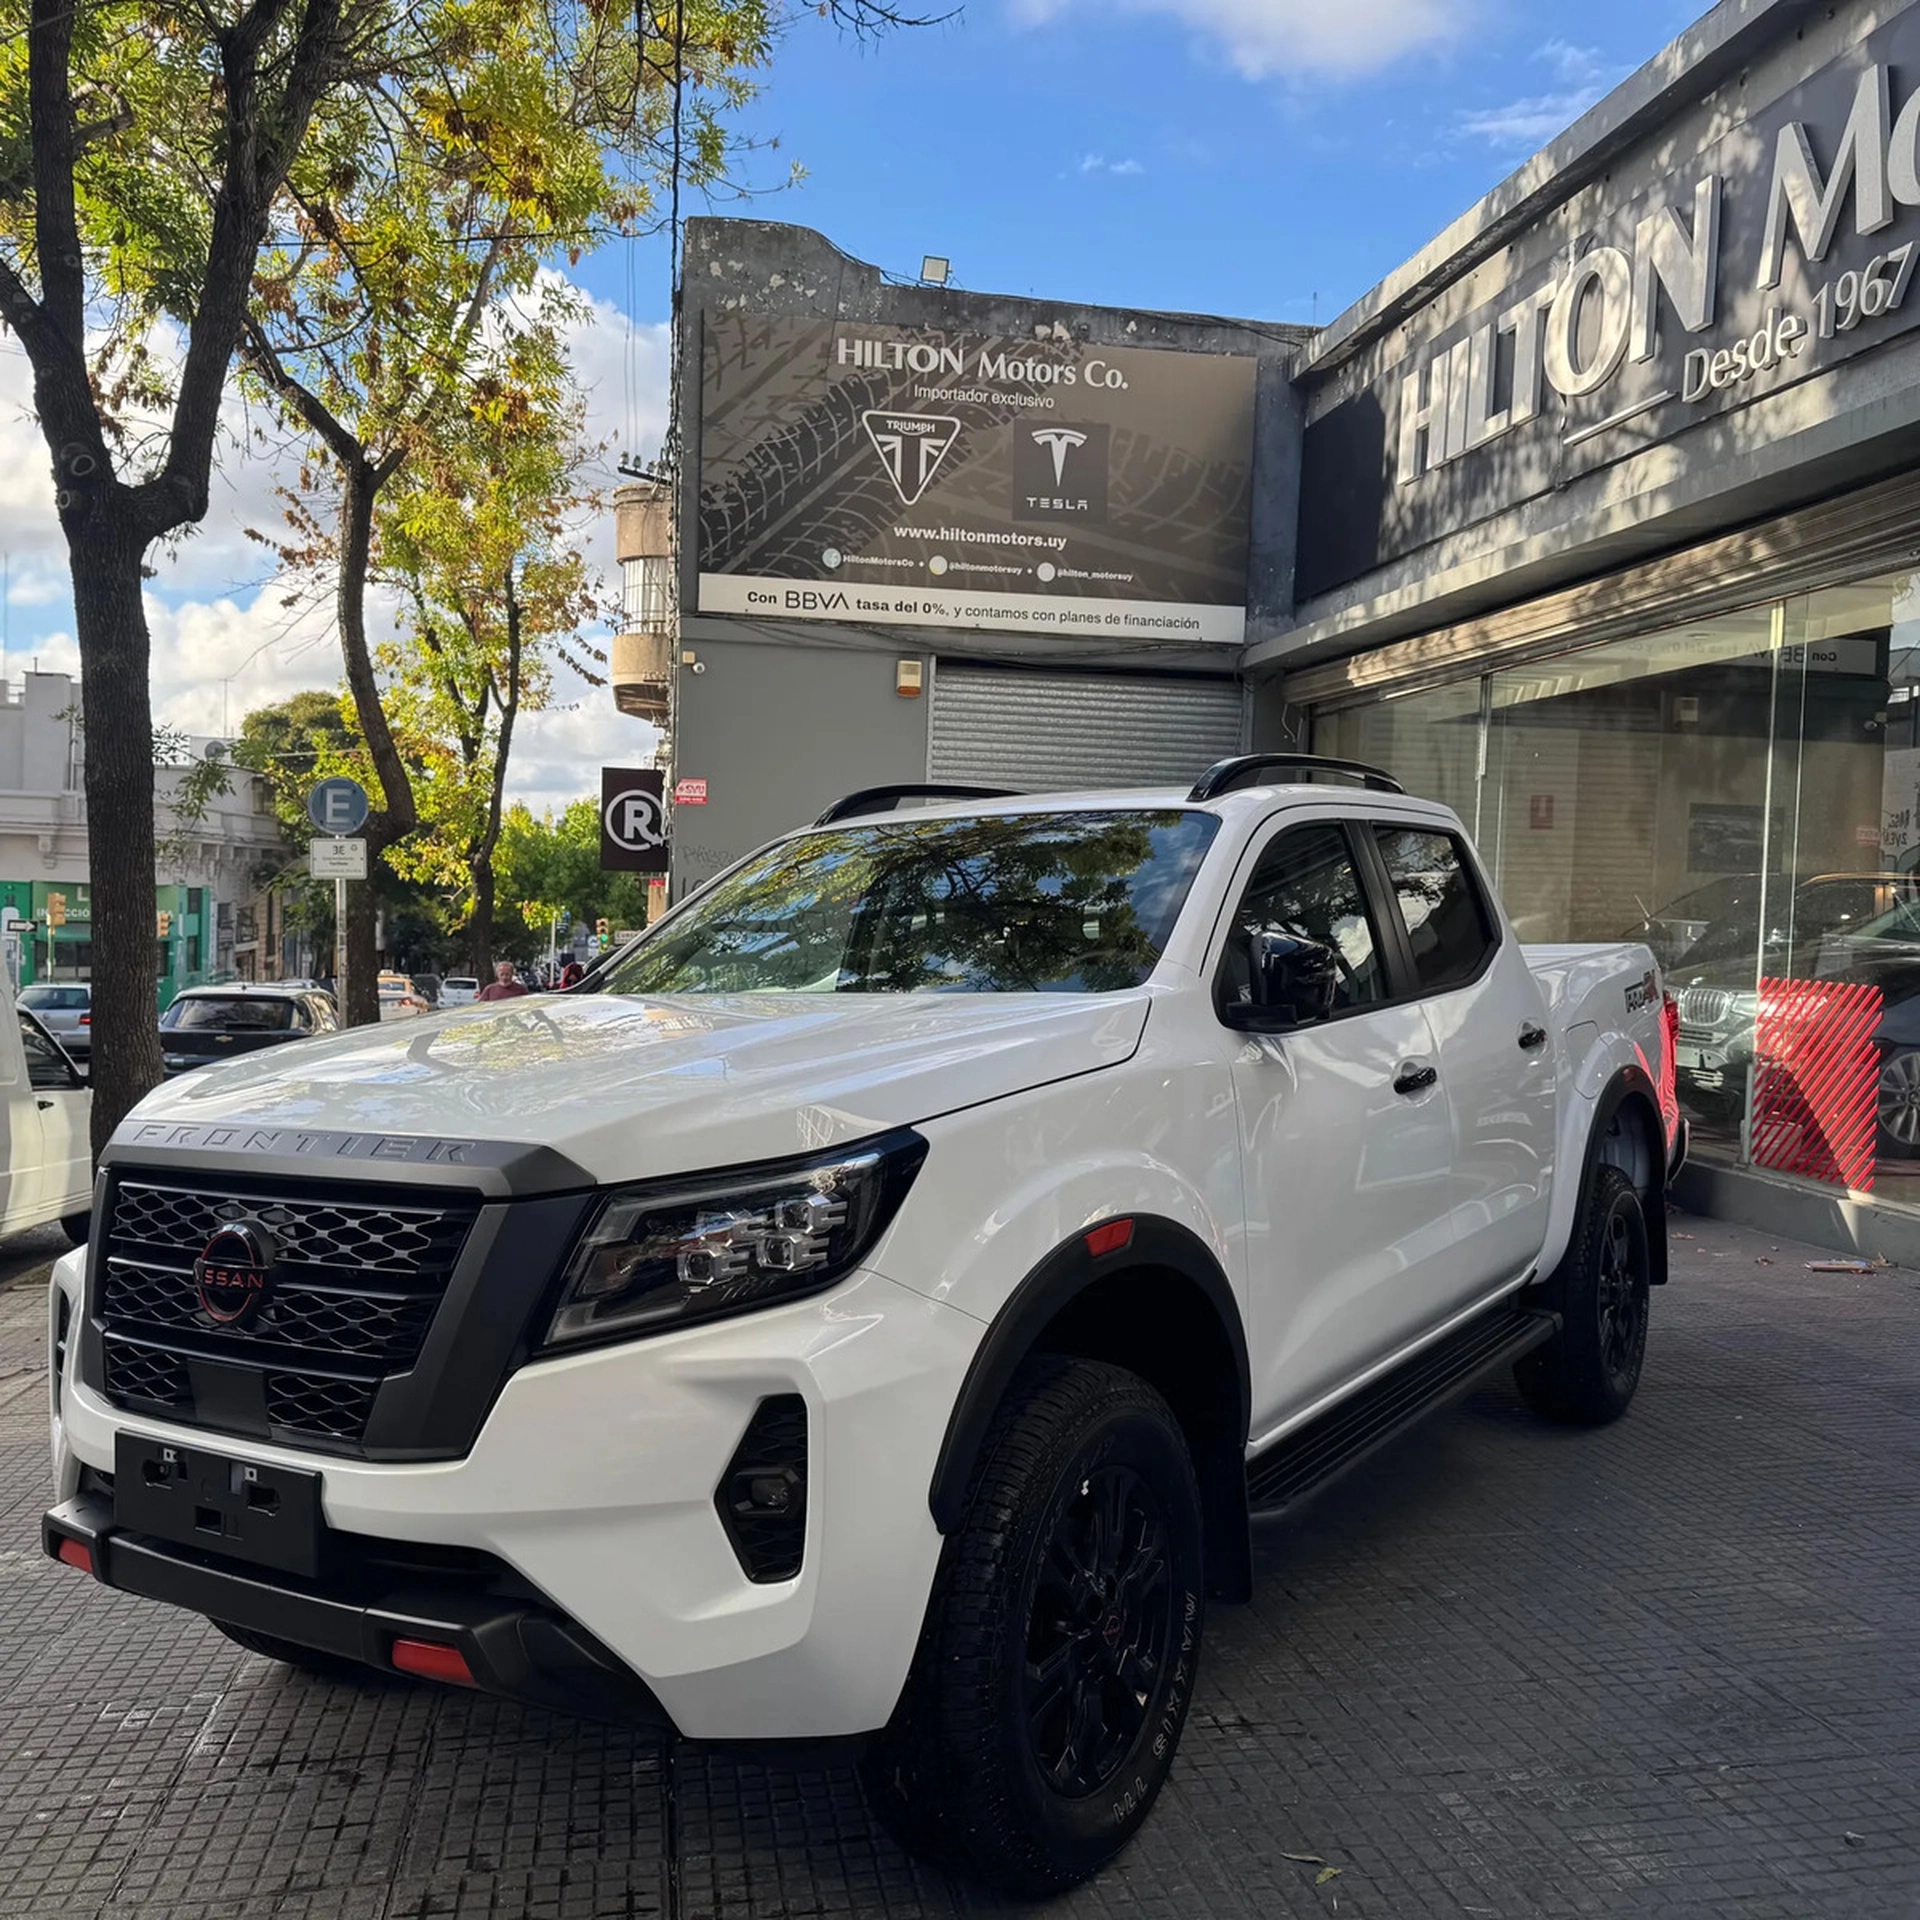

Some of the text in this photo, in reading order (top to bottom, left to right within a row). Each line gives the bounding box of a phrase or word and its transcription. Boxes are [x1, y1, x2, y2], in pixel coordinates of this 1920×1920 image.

[1397, 174, 1723, 487] HILTON
[1682, 241, 1920, 403] Desde 1967
[837, 337, 1129, 390] HILTON Motors Co.
[914, 383, 1055, 408] Importador exclusivo
[886, 419, 936, 434] TRIUMPH
[1026, 496, 1088, 511] TESLA
[893, 525, 1067, 550] www.hiltonmotors.uy
[842, 554, 914, 568] HiltonMotorsCo
[747, 591, 778, 604] Con
[785, 590, 850, 610] BBVA
[856, 598, 890, 612] tasa
[894, 600, 918, 614] del
[953, 605, 962, 618] y
[965, 606, 1029, 620] contamos
[1032, 611, 1056, 622] con
[1059, 610, 1101, 625] planes
[1104, 611, 1121, 625] de
[1123, 613, 1200, 630] financiación
[326, 788, 352, 823] E
[133, 1124, 477, 1163] FRONTIER
